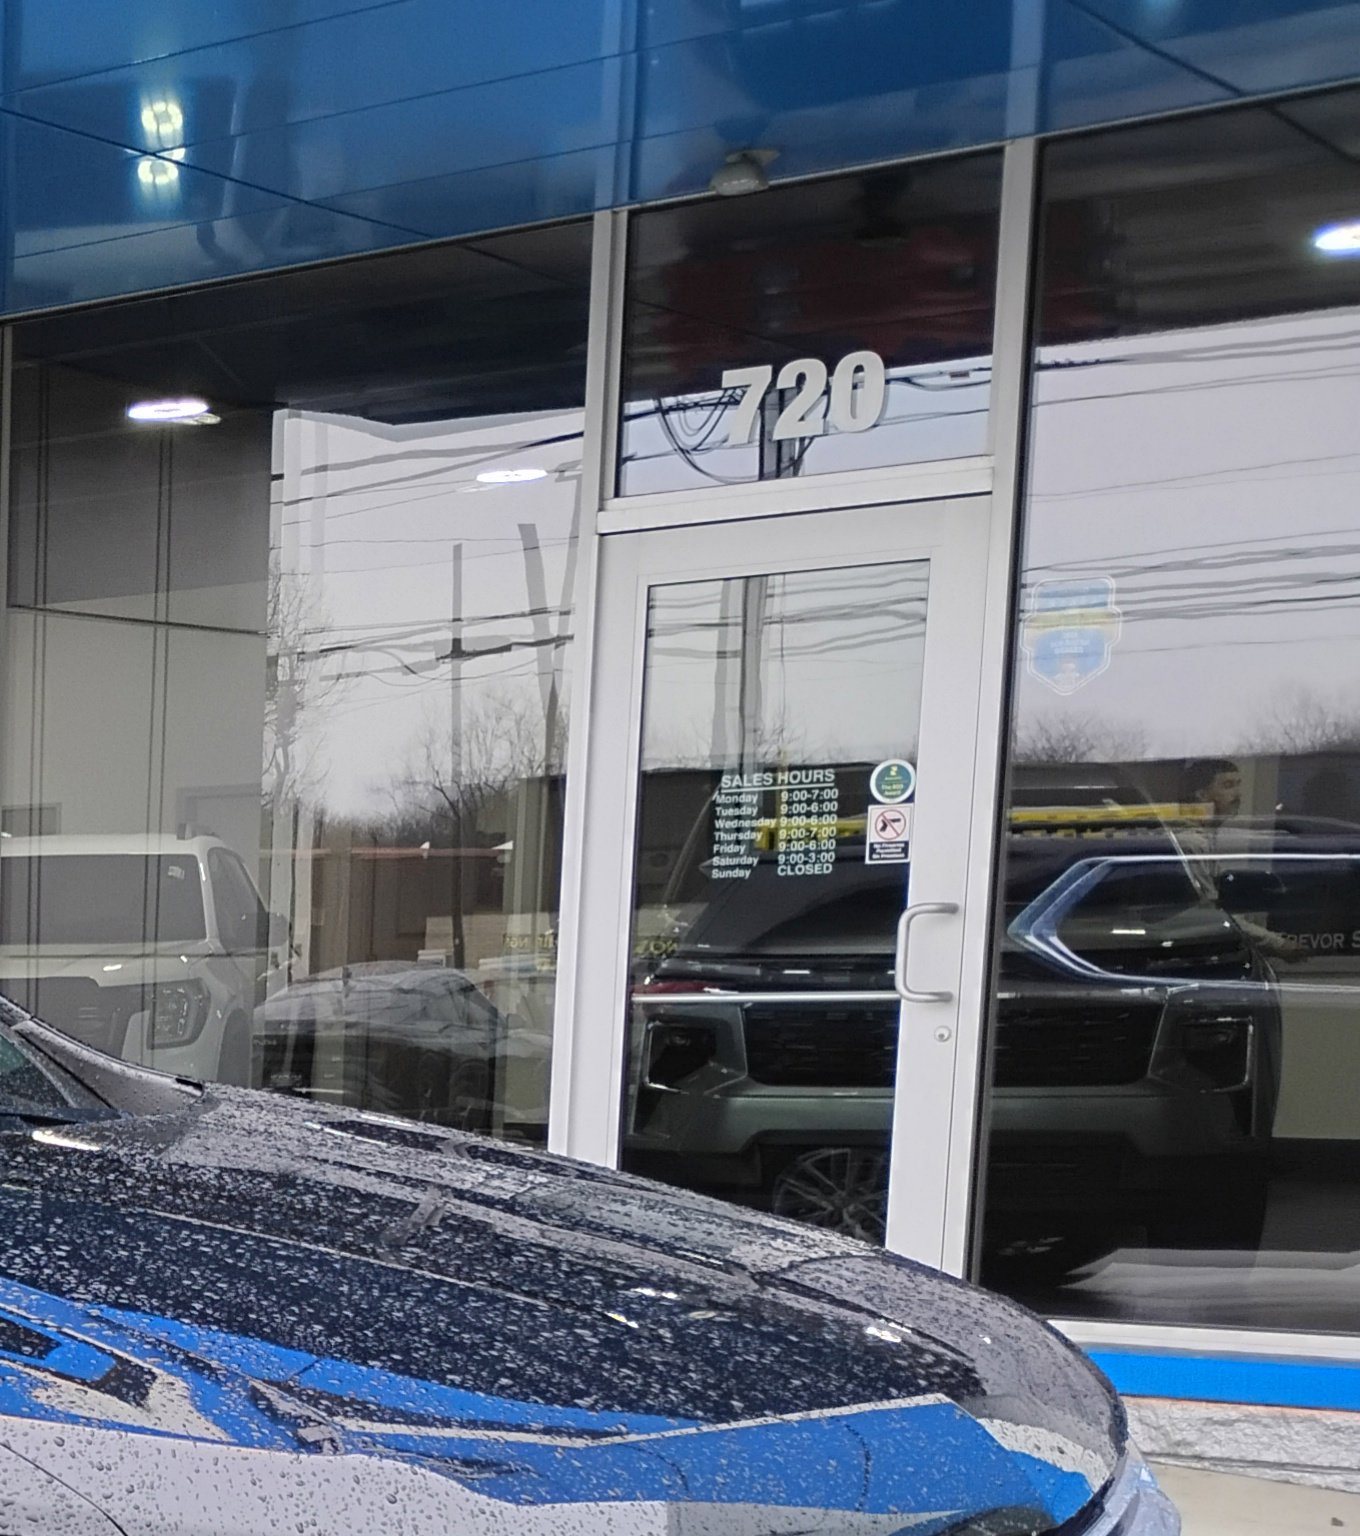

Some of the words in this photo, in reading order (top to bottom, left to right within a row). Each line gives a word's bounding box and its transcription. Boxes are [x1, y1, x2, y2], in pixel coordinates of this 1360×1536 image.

[720, 350, 888, 446] 720
[721, 772, 773, 788] SALES
[777, 769, 836, 785] HOURS
[716, 793, 758, 805] Monday
[781, 789, 838, 803] 9:00-7:00
[715, 806, 758, 818] Tuesday
[780, 802, 837, 815] 9:00-6:00
[714, 818, 777, 830] Wednesday
[780, 814, 836, 828] 9:00-6:00
[714, 831, 763, 843] Thursday
[779, 827, 836, 840] 9:00-7:00
[713, 844, 746, 856] Friday
[778, 840, 835, 853] 9:00-6:00
[712, 856, 759, 868] Saturday
[778, 852, 835, 866] 9:00-3:00
[711, 869, 752, 881] Sunday
[777, 863, 832, 876] CLOSED
